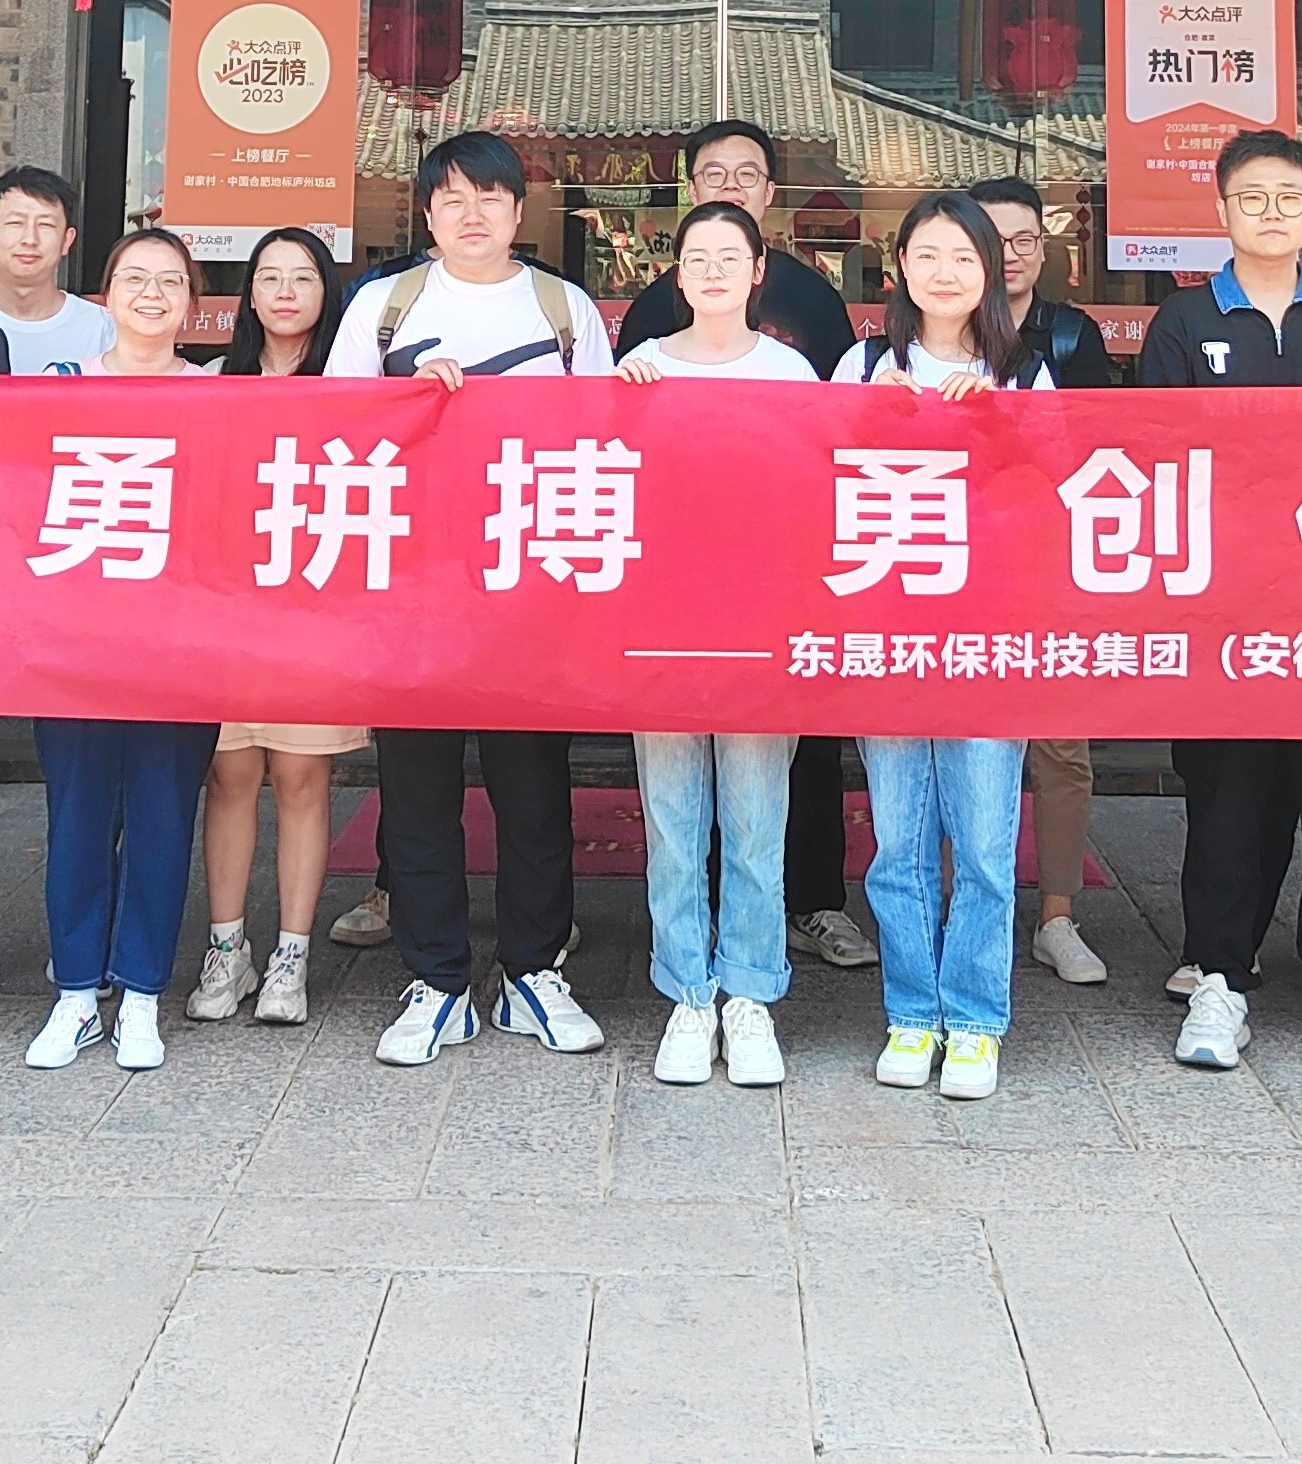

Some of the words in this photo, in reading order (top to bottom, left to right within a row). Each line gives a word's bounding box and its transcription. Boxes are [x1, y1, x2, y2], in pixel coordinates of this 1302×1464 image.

[1179, 5, 1243, 23] 大众点评
[244, 40, 302, 56] 大众点评
[214, 57, 307, 86] 必吃榜
[1148, 48, 1255, 84] 热门榜
[241, 88, 284, 104] 2023
[1177, 137, 1225, 151] 上榜餐厅
[231, 148, 291, 164] 上榜餐厅
[195, 234, 234, 246] 大众点评
[1139, 245, 1178, 256] 大众点评
[183, 308, 236, 332] 古镇
